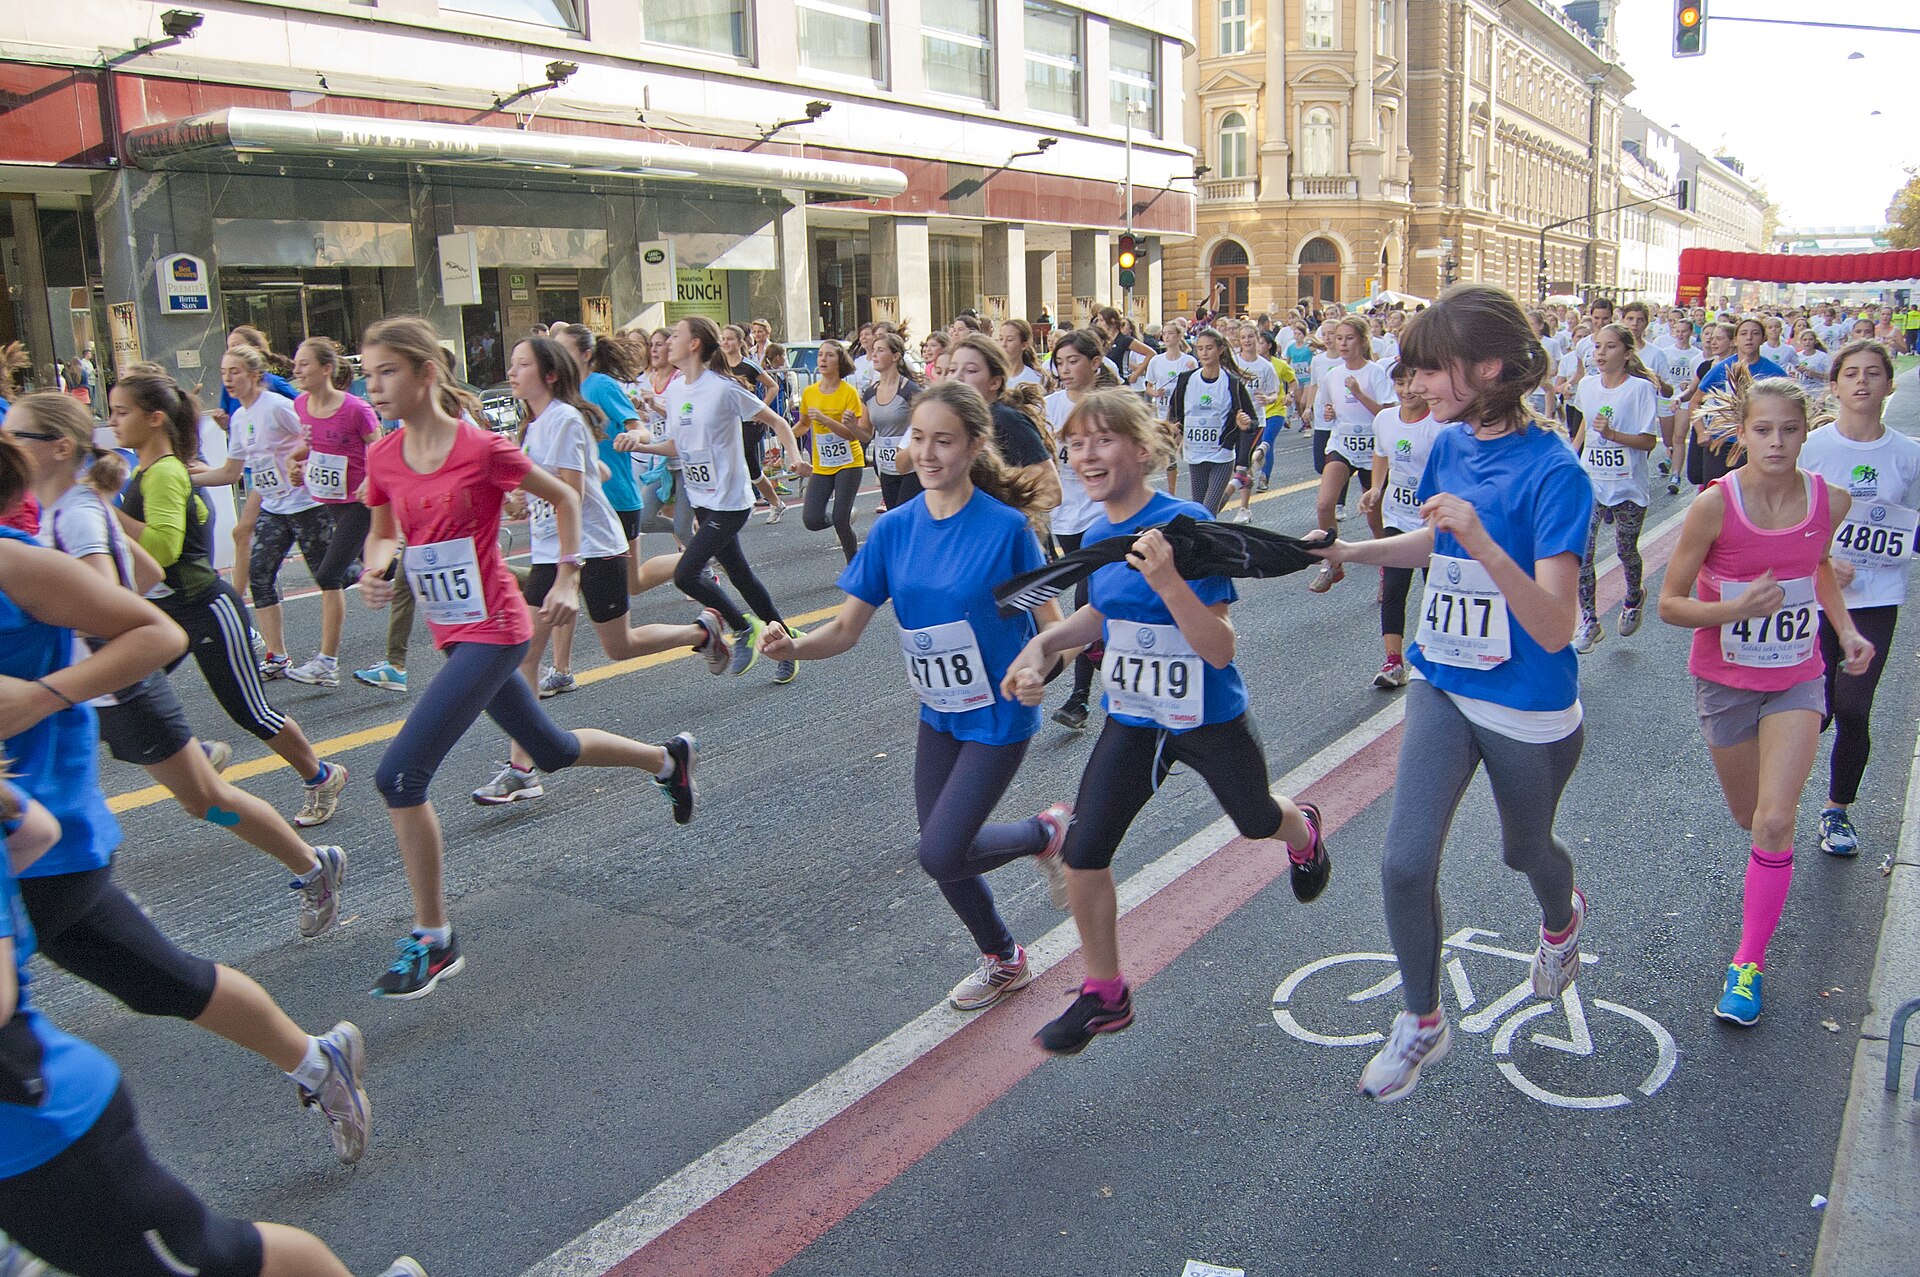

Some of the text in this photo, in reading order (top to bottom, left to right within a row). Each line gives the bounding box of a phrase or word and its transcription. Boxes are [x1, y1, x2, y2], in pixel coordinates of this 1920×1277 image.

[678, 284, 722, 300] RUNCH
[115, 341, 138, 352] BRUNCH
[1187, 428, 1217, 442] 4686
[1343, 436, 1375, 451] 4554
[821, 442, 847, 458] 4625
[879, 448, 896, 461] 462
[1588, 449, 1625, 467] 4565
[308, 468, 340, 487] 4656
[1393, 487, 1424, 507] 456
[1836, 524, 1904, 557] 4805
[417, 568, 470, 602] 4715
[1426, 593, 1491, 638] 4717
[1732, 607, 1810, 643] 4762
[911, 653, 973, 689] 4718
[1111, 656, 1188, 699] 4719
